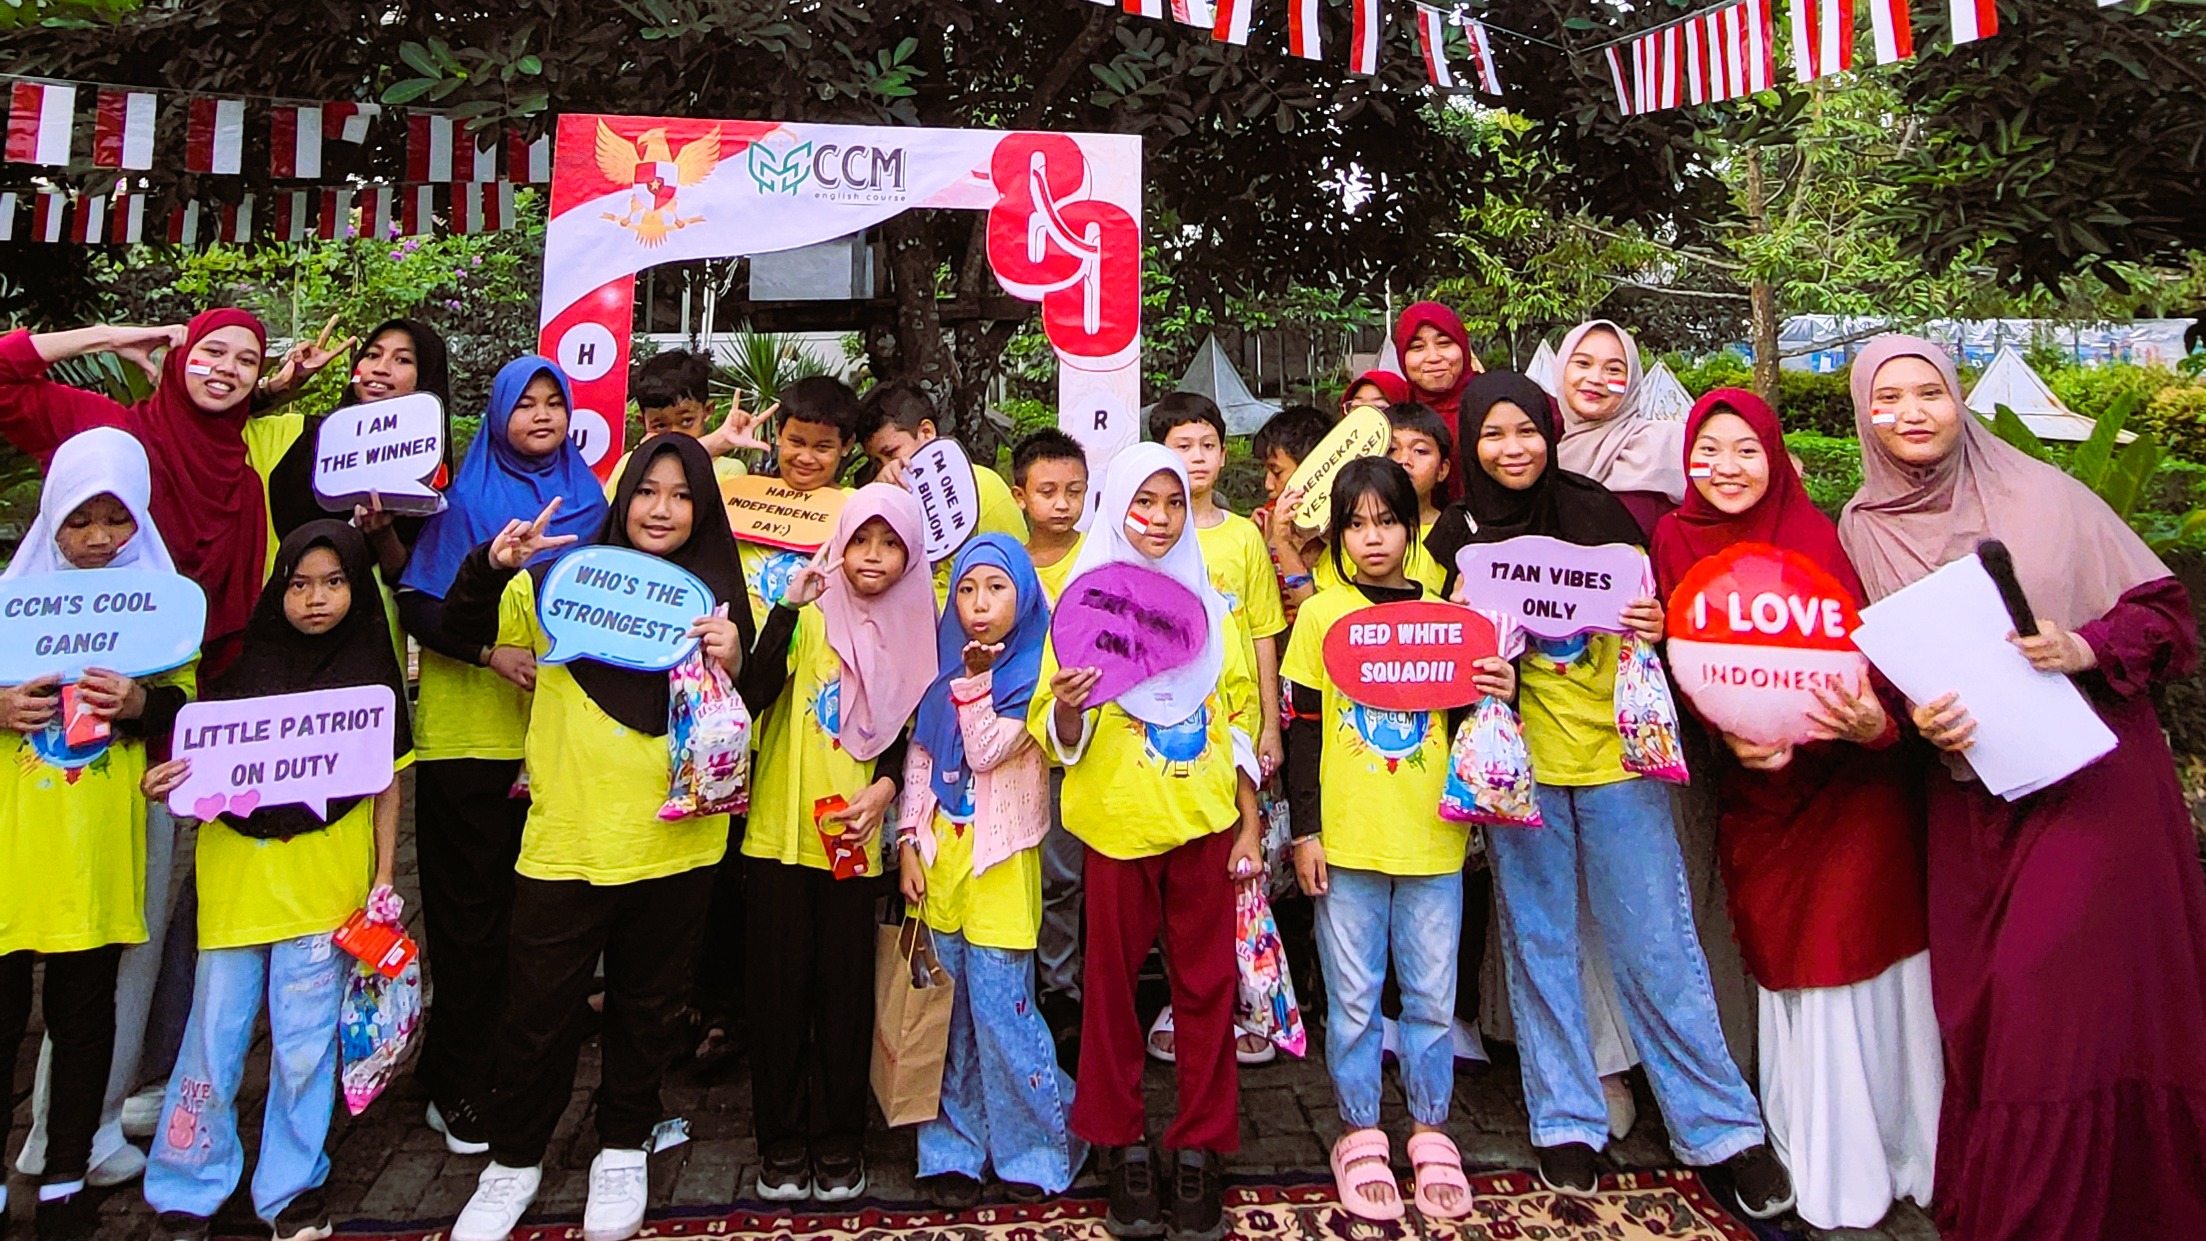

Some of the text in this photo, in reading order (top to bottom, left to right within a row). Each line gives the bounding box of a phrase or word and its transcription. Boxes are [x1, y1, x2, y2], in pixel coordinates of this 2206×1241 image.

[813, 144, 906, 191] CCM
[814, 192, 906, 201] english course
[577, 343, 596, 365] H
[356, 414, 397, 436] I AM
[1094, 410, 1108, 430] R
[320, 436, 437, 474] THE WINNER
[765, 486, 813, 502] HAPPY
[931, 450, 965, 530] I'M ONE IN
[727, 497, 829, 523] INDEPENDENCE
[912, 467, 945, 542] A BILLION
[575, 565, 689, 607] WHO'S THE
[1491, 562, 1612, 590] 17AN VIBES
[5, 592, 157, 618] CCM'S COOL
[1522, 598, 1577, 620] ONLY
[1694, 591, 1846, 638] I LOVE
[548, 598, 687, 645] STRONGEST?
[1349, 622, 1463, 646] RED WHITE
[183, 707, 384, 750] LITTLE PATRIOT
[231, 753, 339, 787] ON DUTY
